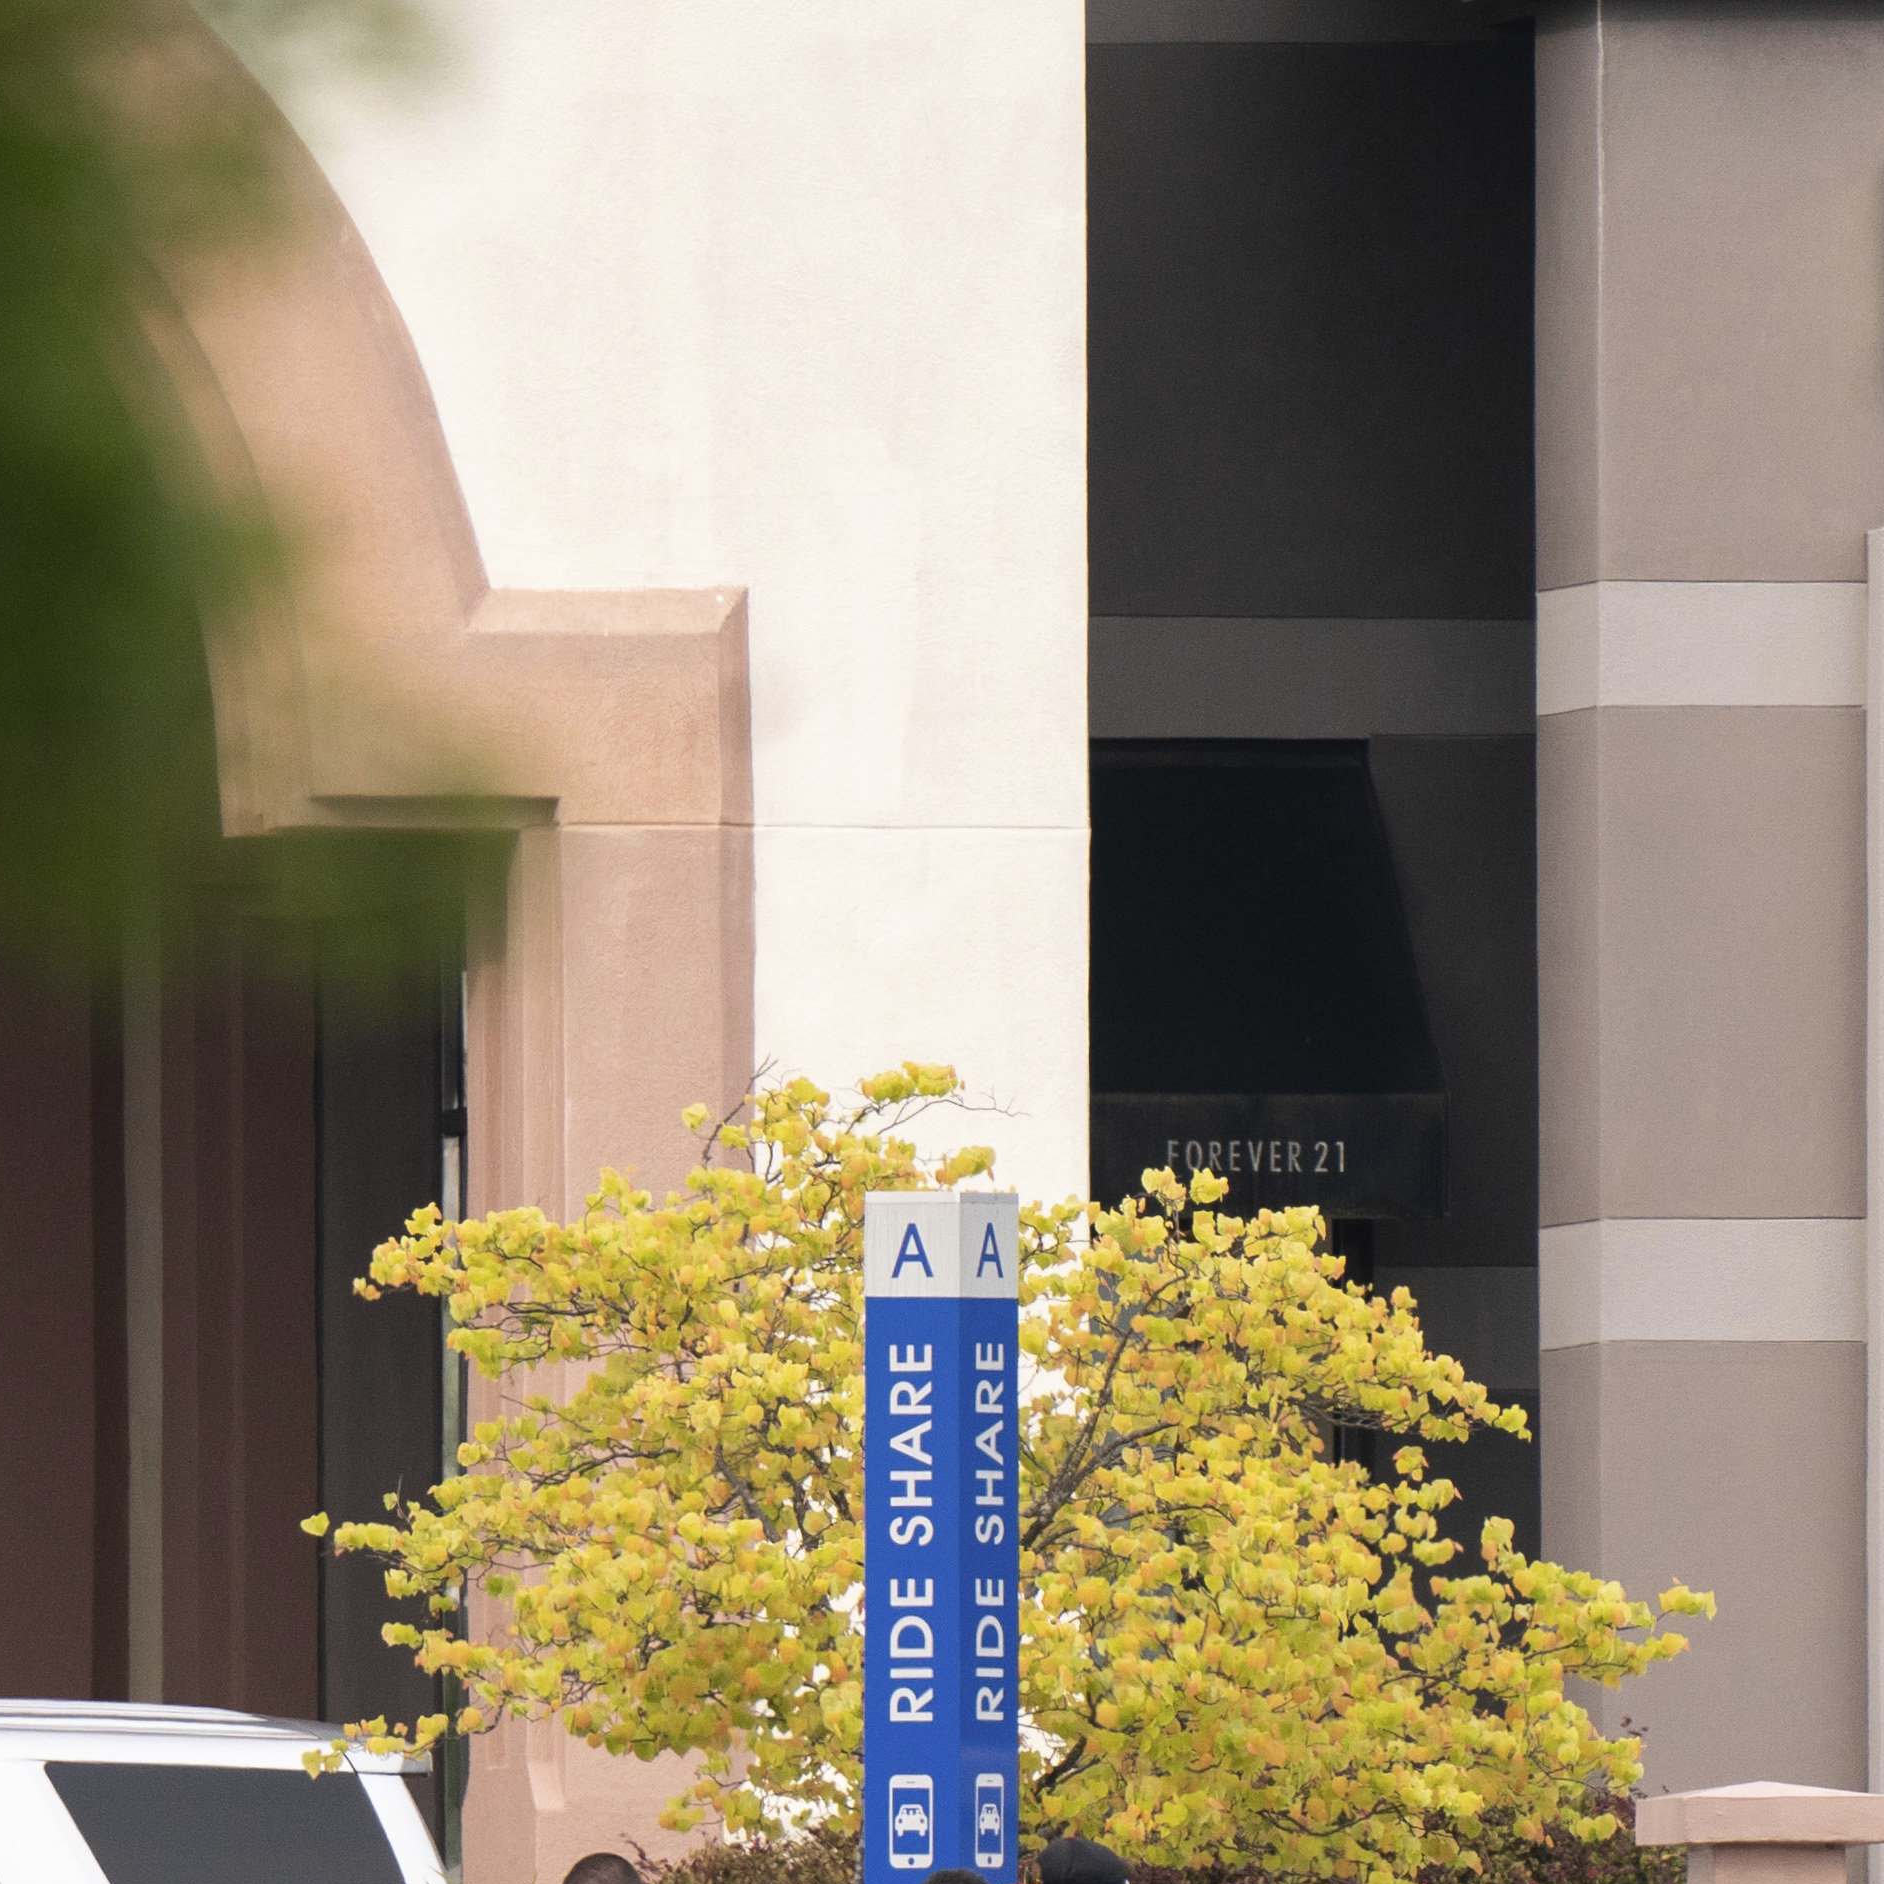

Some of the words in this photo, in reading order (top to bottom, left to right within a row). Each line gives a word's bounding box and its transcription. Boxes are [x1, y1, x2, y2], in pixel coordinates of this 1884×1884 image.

[1167, 1139, 1303, 1173] FOREVER
[1314, 1141, 1346, 1173] 21
[891, 1222, 934, 1279] A
[976, 1221, 1004, 1279] A
[889, 1343, 934, 1547] SHARE
[974, 1342, 1005, 1546] SHARE
[889, 1577, 934, 1723] RIDE
[975, 1577, 1005, 1722] RIDE
